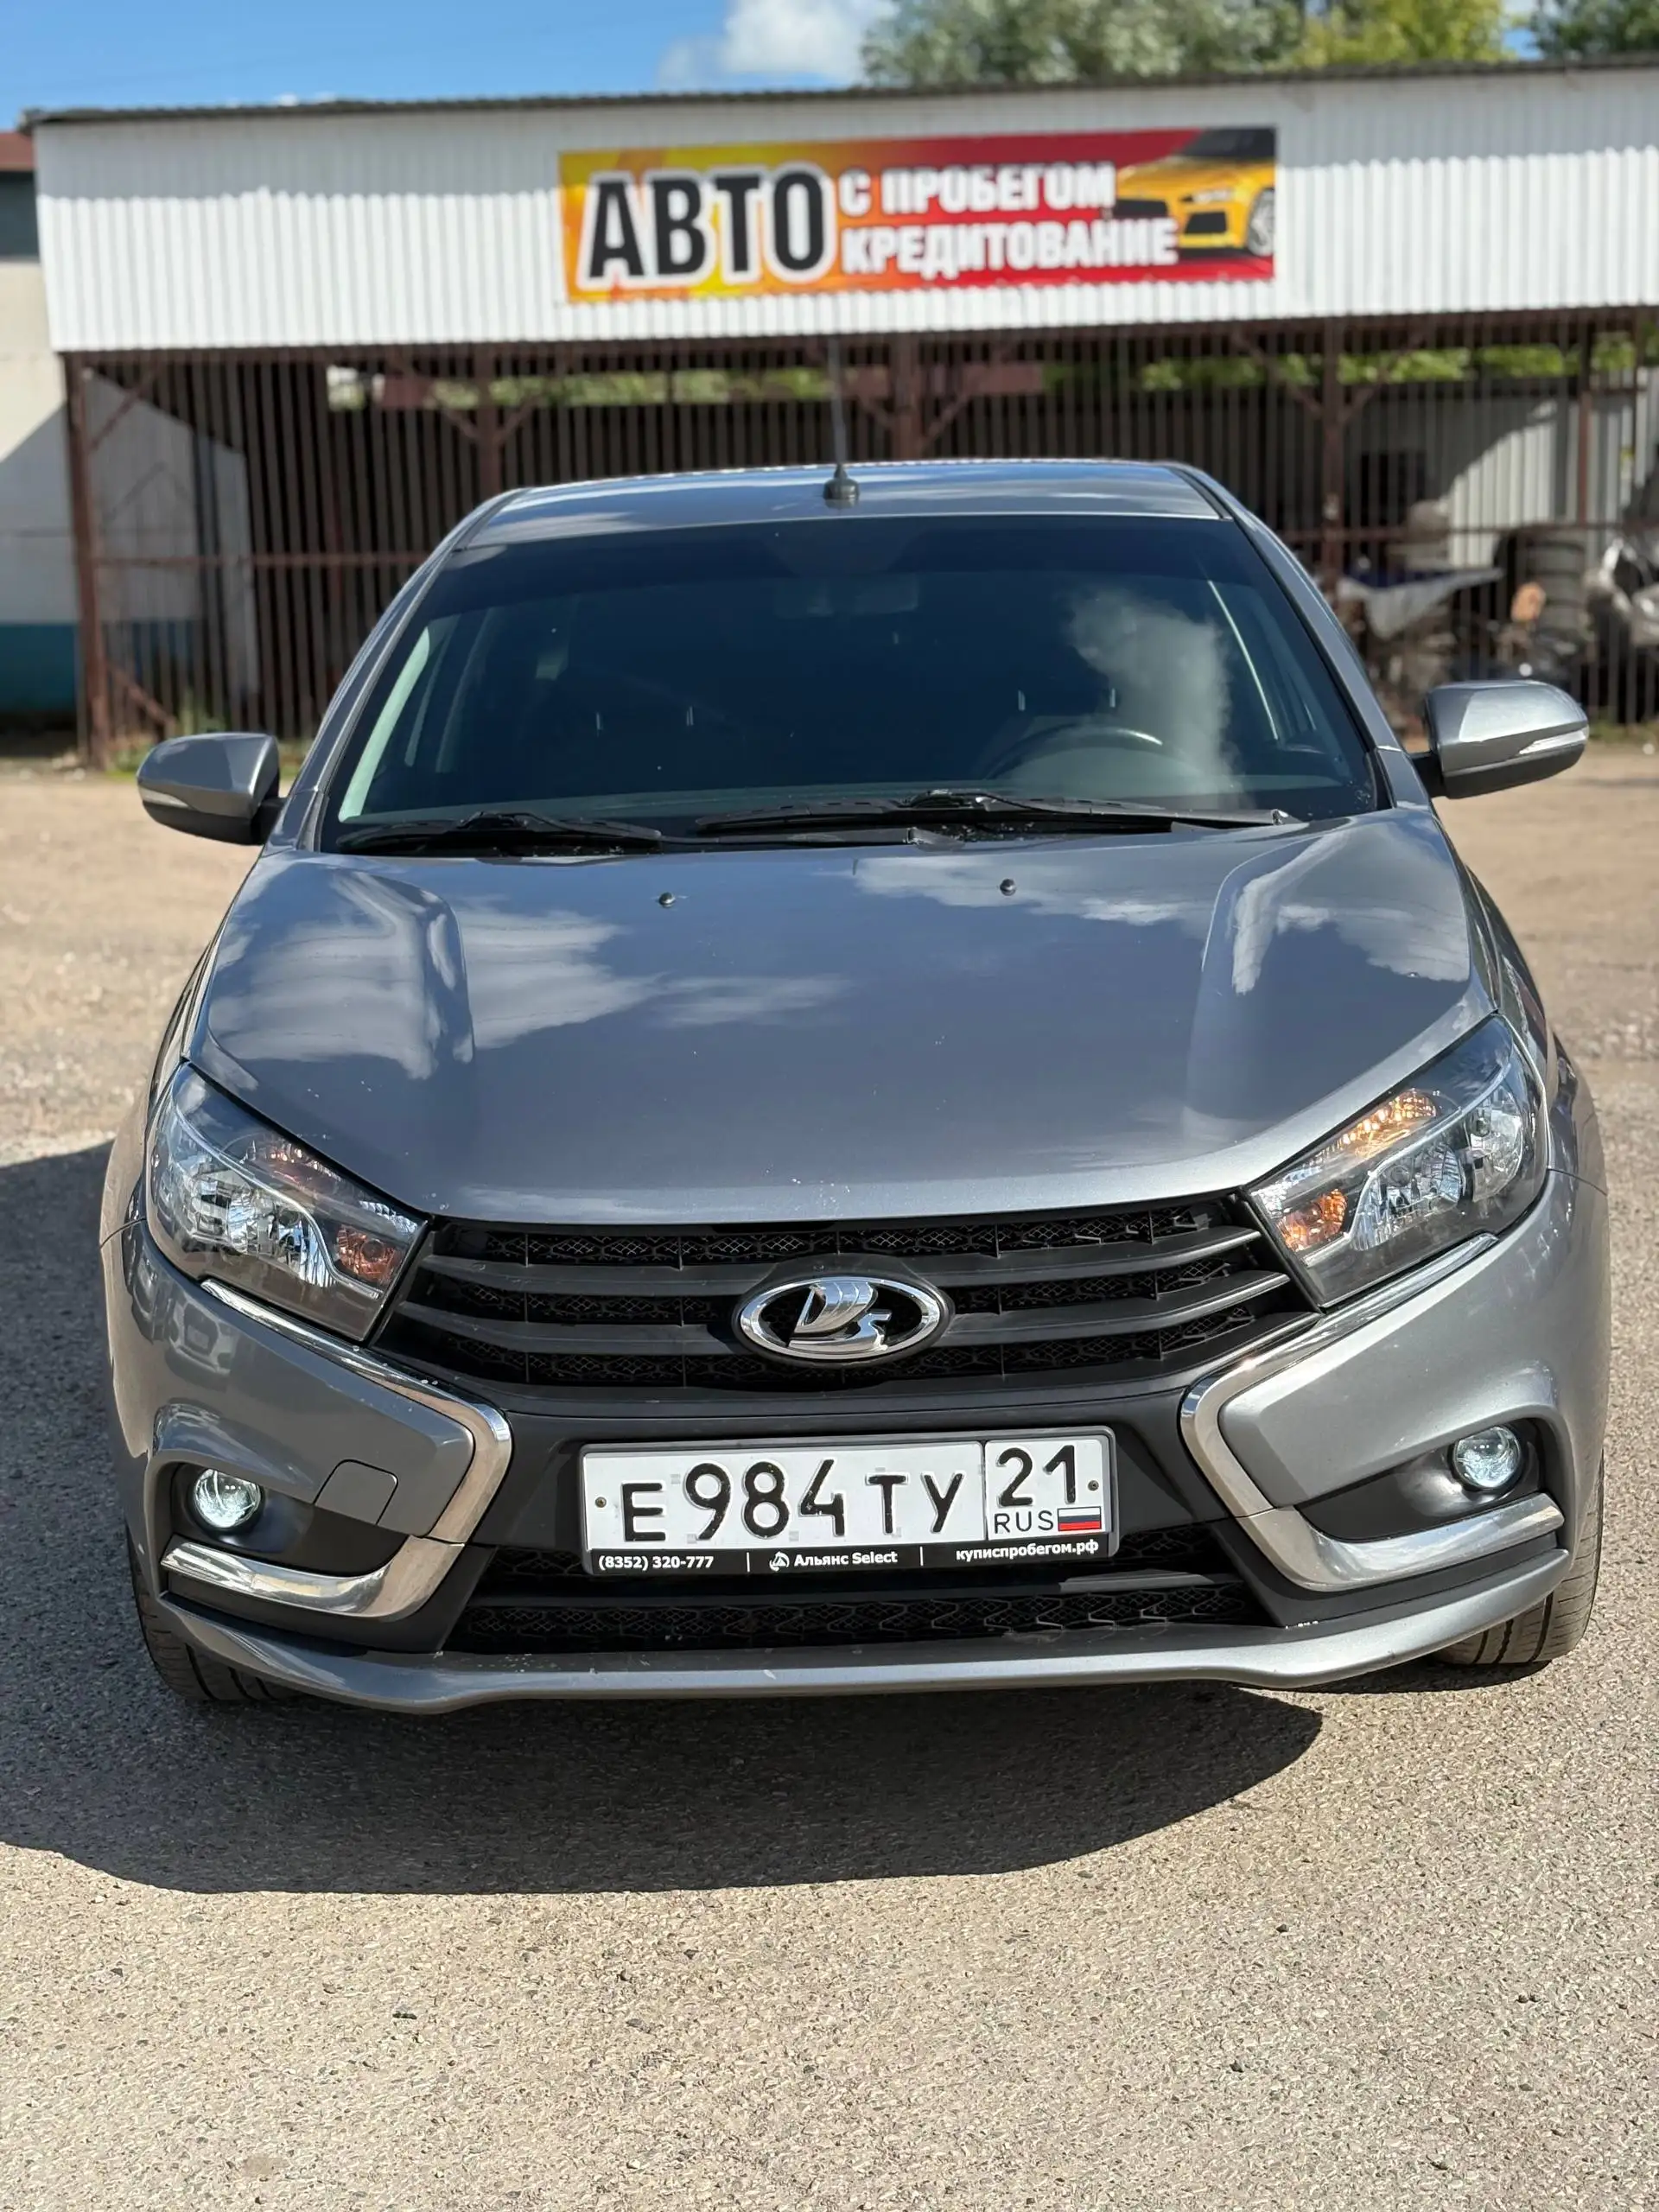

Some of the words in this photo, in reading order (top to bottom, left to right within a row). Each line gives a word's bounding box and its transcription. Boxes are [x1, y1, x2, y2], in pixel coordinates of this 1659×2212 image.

[839, 170, 868, 215] С
[883, 162, 1116, 215] ПРОБЕГОМ
[584, 167, 830, 283] АВТО
[840, 218, 1179, 281] КРЕДИТОВАНИЕ
[997, 1445, 1077, 1507] 21
[995, 1510, 1054, 1535] RUS
[598, 1556, 648, 1572] (8352)
[652, 1556, 714, 1569] 320-777
[794, 1554, 849, 1567] Альянс
[852, 1551, 898, 1564] Select
[956, 1538, 1099, 1562] куписпробегом.рф
